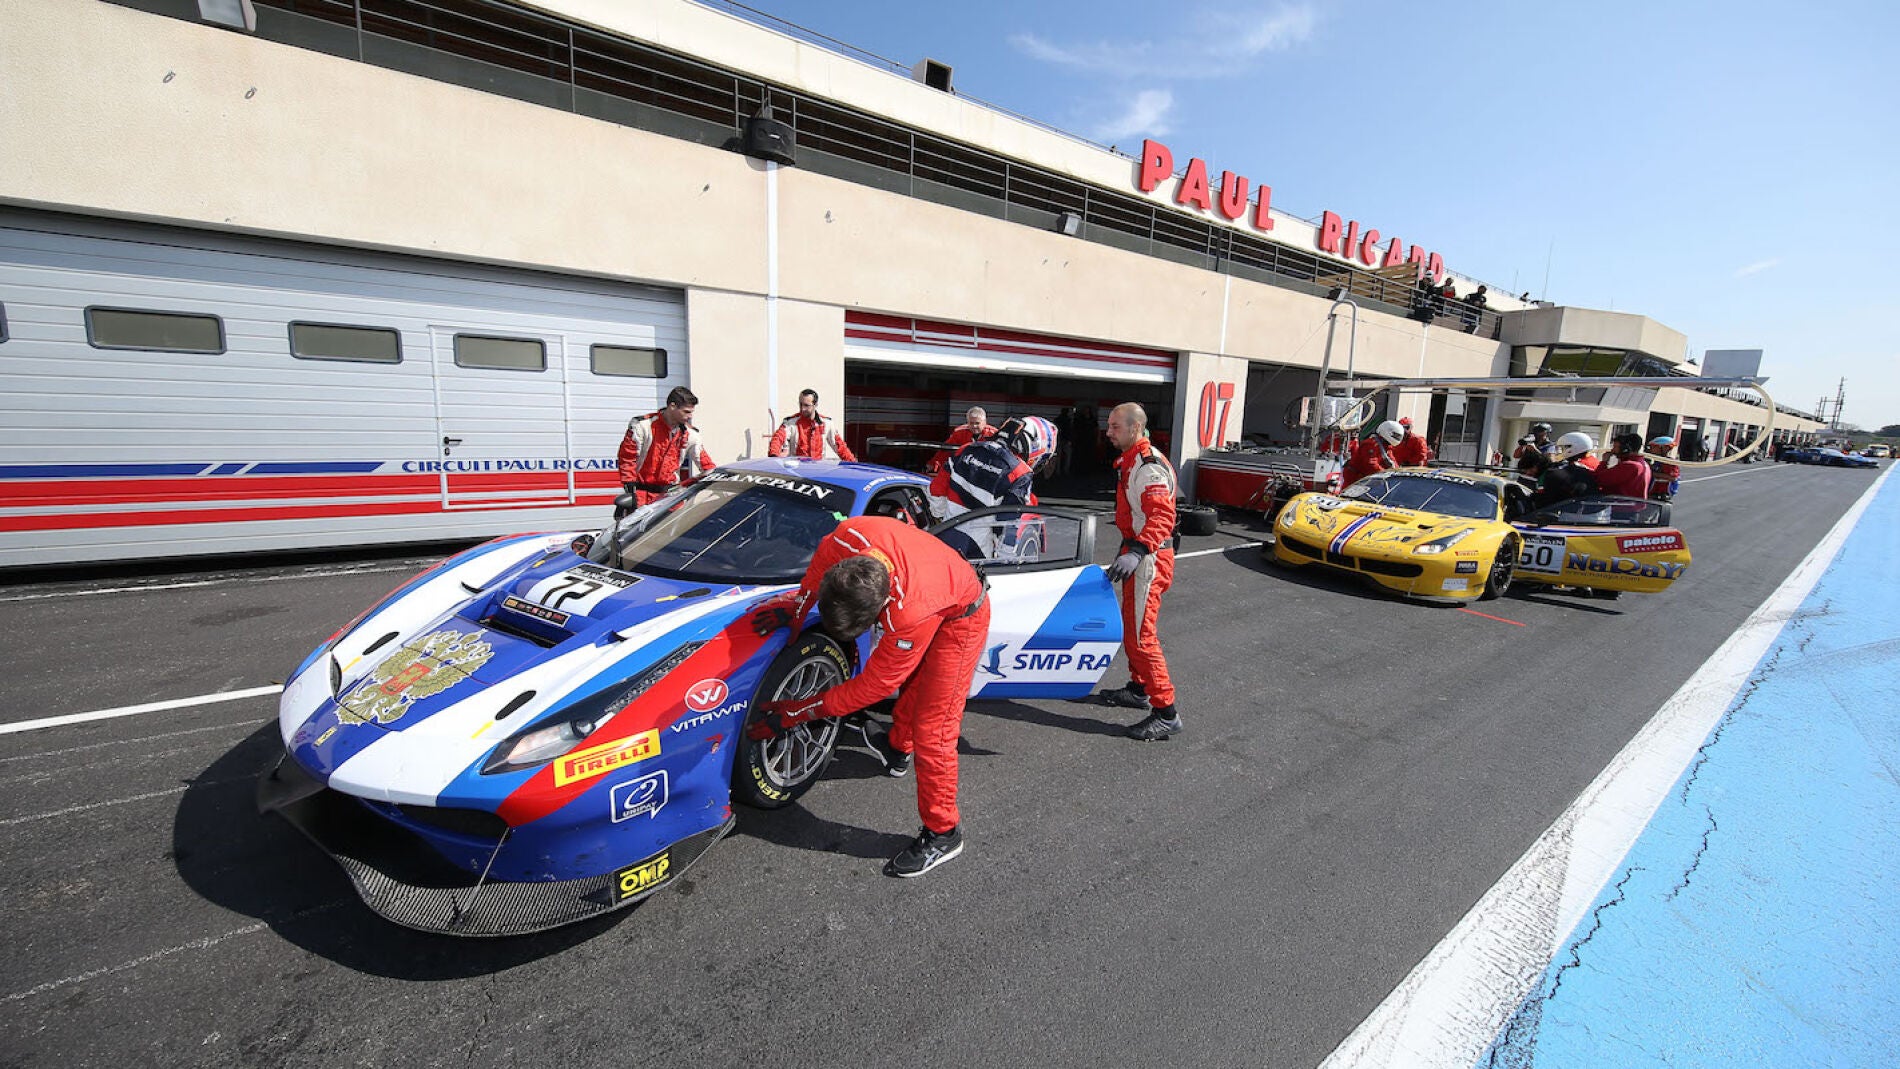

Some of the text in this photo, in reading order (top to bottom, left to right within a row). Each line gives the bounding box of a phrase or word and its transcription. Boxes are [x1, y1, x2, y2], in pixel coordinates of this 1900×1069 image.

[1138, 138, 1274, 231] PAUL
[1197, 381, 1235, 448] 07
[402, 458, 619, 473] CIRCUIT PAUL RICAR
[700, 472, 834, 499] BLANCPAIN
[1519, 545, 1554, 566] 50
[1623, 535, 1676, 549] pakelo
[1013, 653, 1072, 670] SMP
[671, 700, 748, 733] VITAWIN
[564, 736, 650, 779] PIRELLI
[620, 858, 670, 892] OMP
